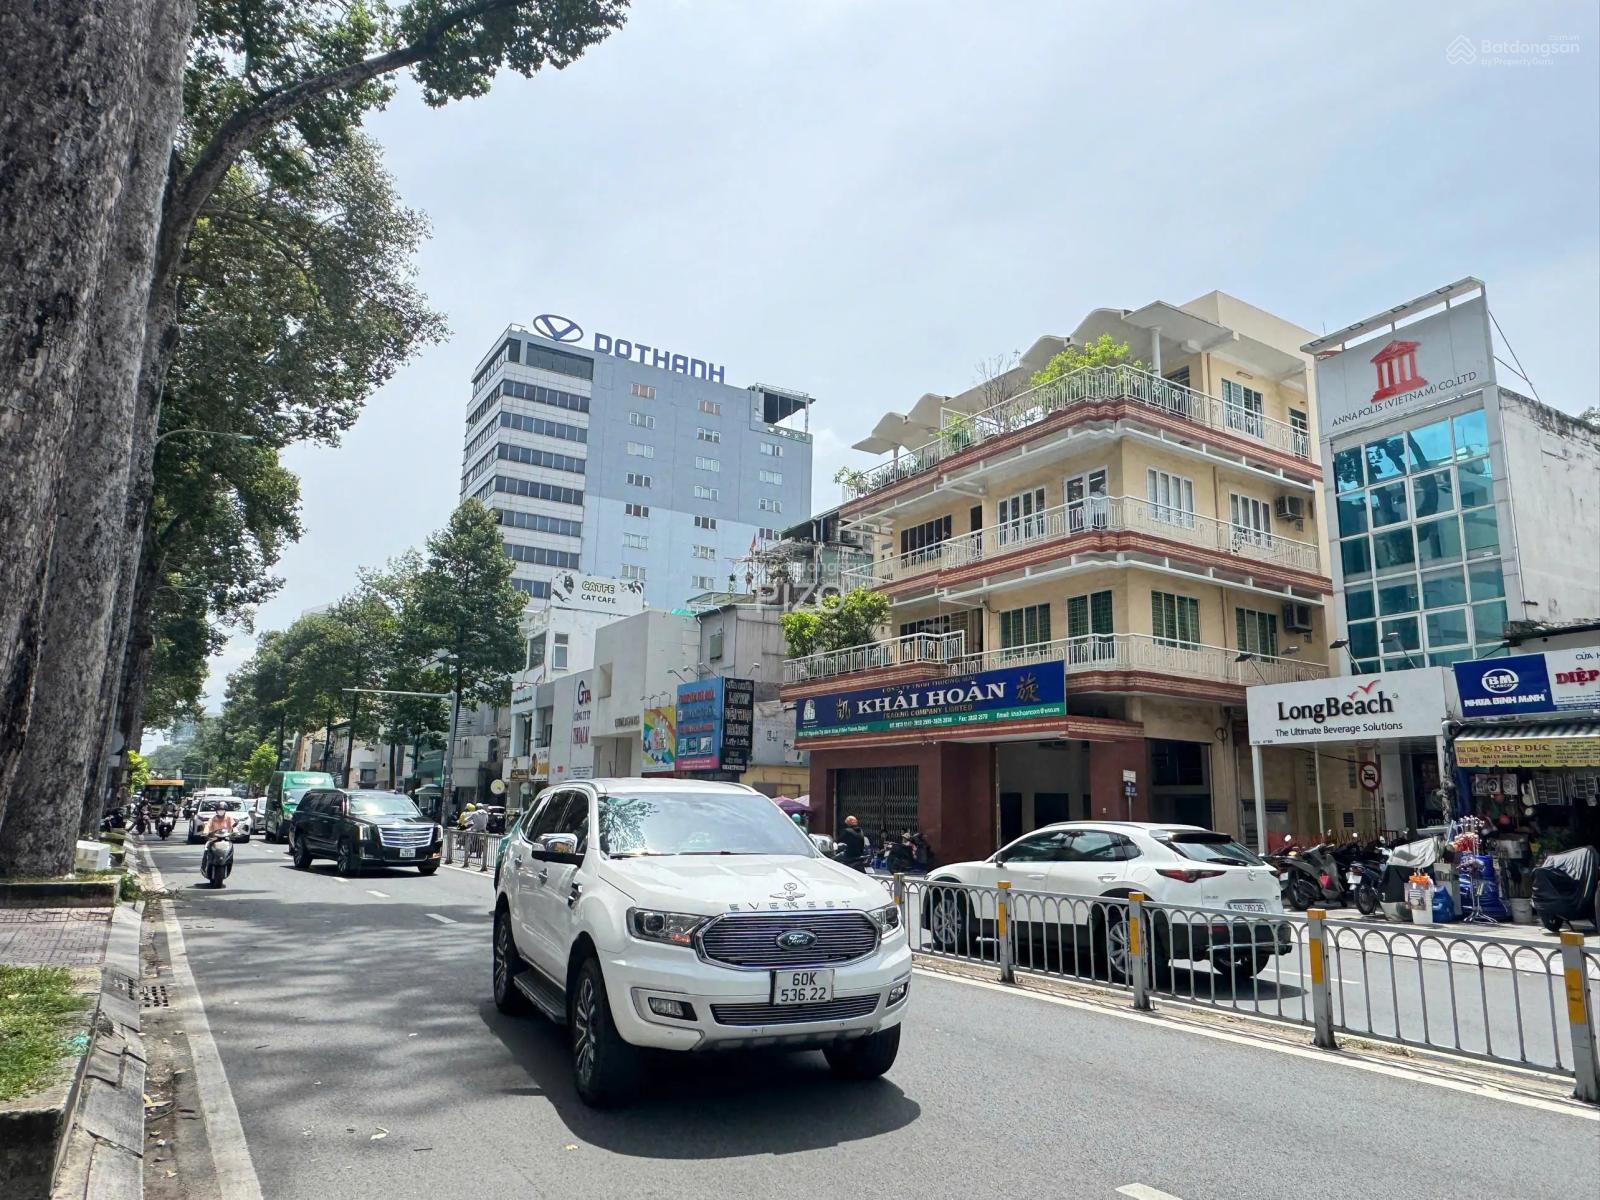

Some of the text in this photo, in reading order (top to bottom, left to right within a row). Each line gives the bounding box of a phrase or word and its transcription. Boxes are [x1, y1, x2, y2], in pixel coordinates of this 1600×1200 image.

[594, 332, 725, 384] DOTHANH
[1332, 402, 1383, 427] ANNAPOLIS
[1384, 384, 1437, 409] (VIETNAM)
[582, 580, 615, 594] CATFE
[597, 596, 616, 604] CAFE
[1488, 674, 1513, 685] BM
[1555, 667, 1600, 686] DIỆP
[857, 681, 1006, 715] KHẢI HOÀN
[910, 706, 942, 717] COMPANY
[1277, 690, 1394, 724] LongBeach
[1276, 721, 1403, 737] The Ultimate Beverage Solutions
[729, 900, 851, 912] EVEREST
[792, 971, 817, 986] 60K
[781, 987, 827, 1002] 536.22
